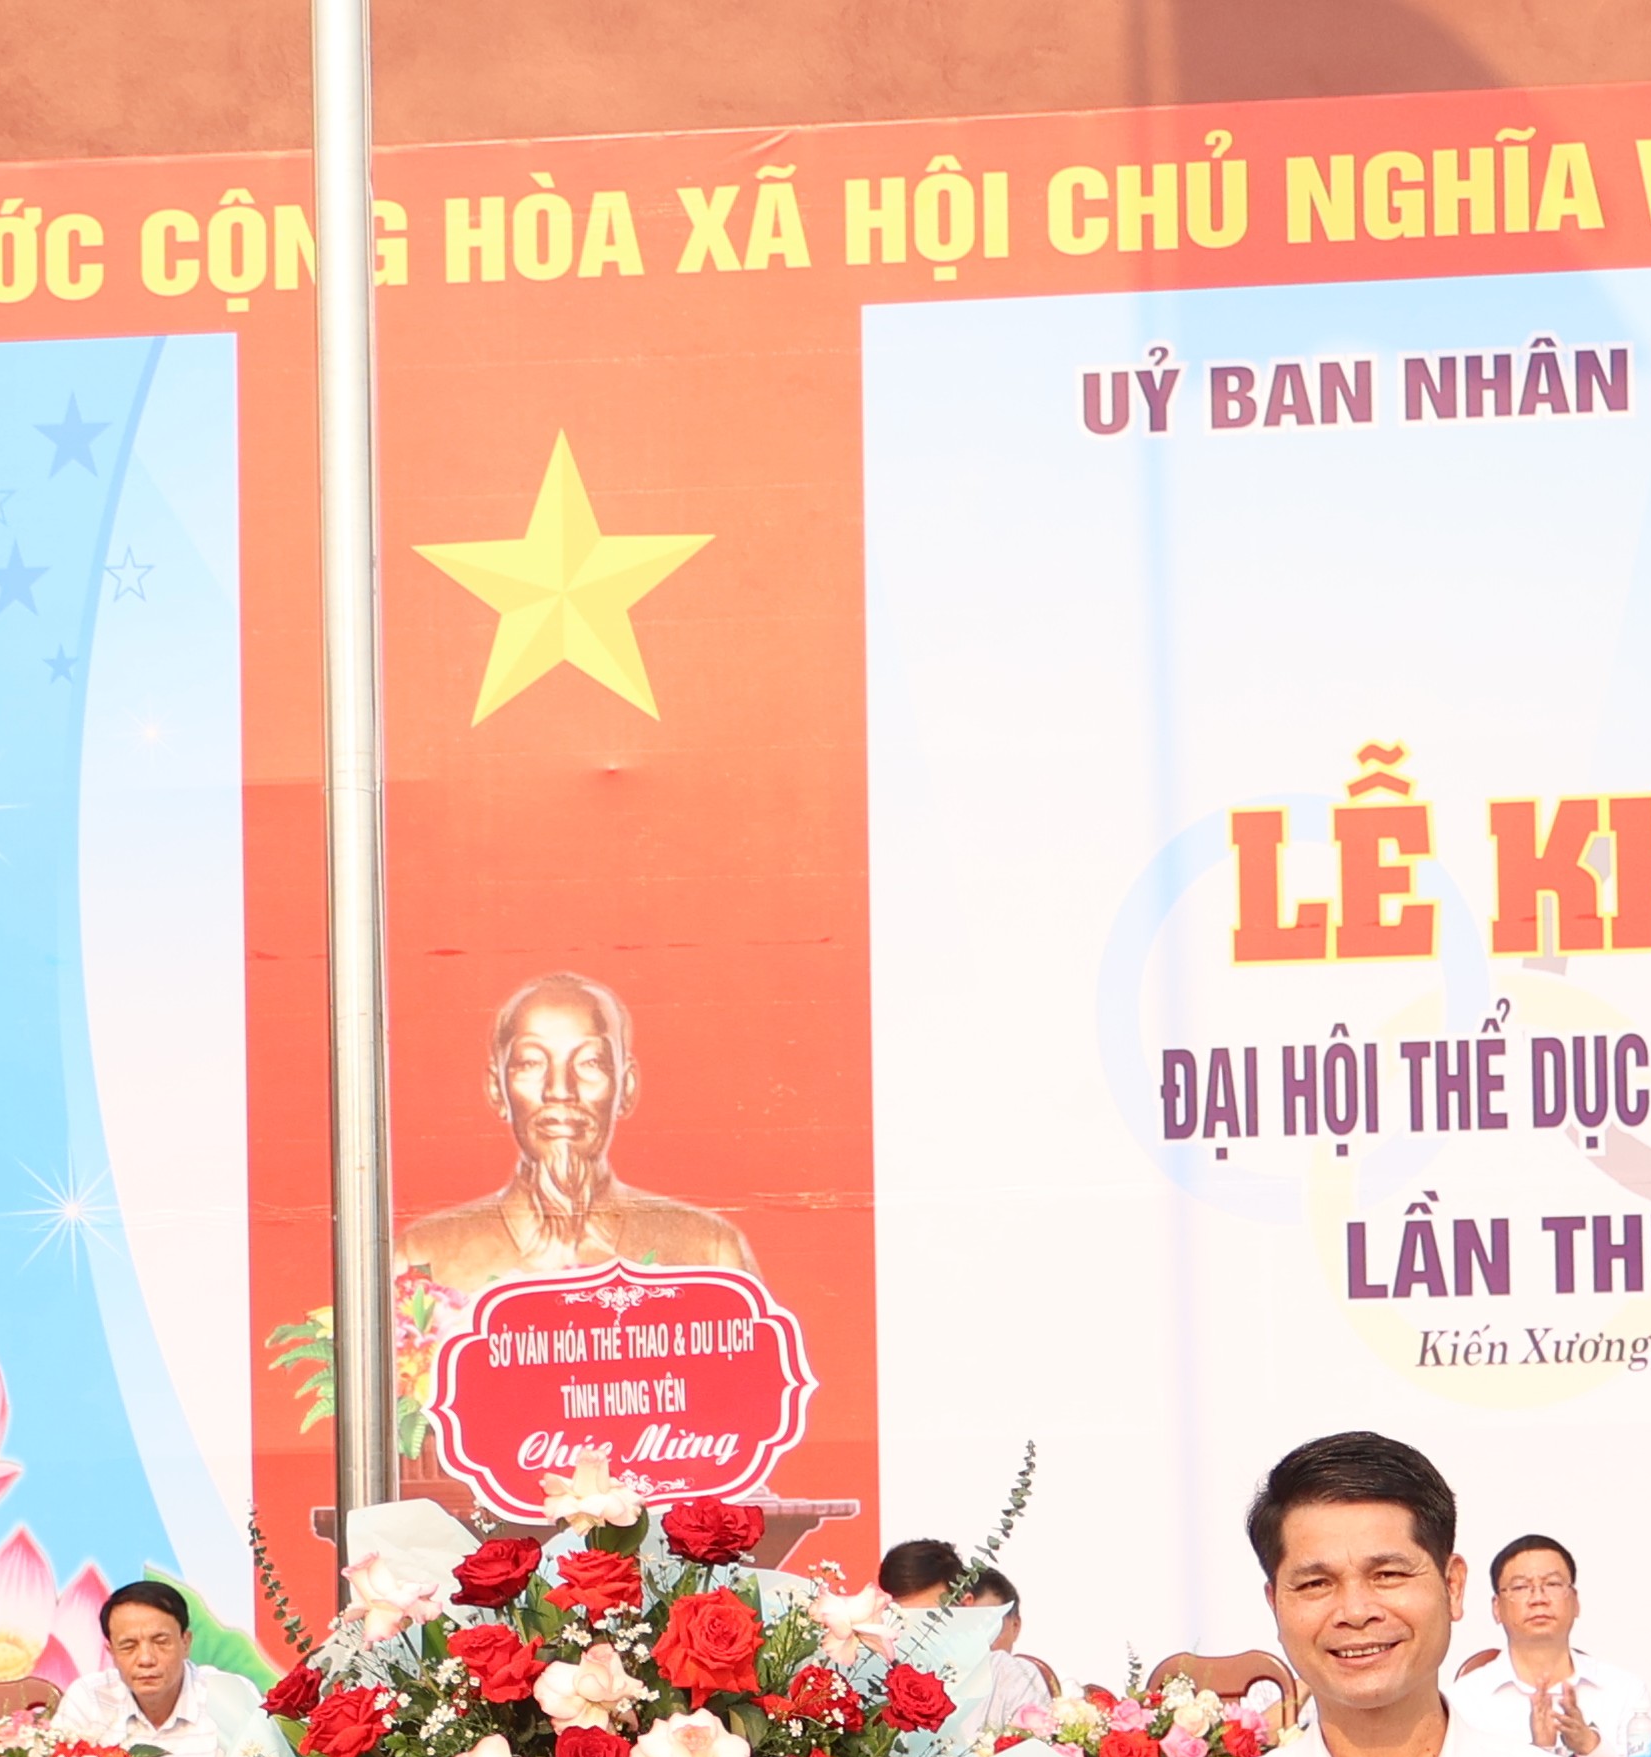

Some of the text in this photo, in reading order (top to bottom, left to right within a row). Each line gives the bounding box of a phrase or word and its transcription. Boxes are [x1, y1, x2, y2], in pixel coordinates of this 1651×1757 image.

[444, 172, 644, 284] HÒA
[676, 162, 811, 273] XÃ
[845, 154, 1009, 281] HỘI
[1047, 129, 1247, 257] CHỦ
[1285, 125, 1605, 244] NGHĨA
[1081, 345, 1180, 435] UỶ
[1209, 359, 1374, 430] BAN
[1403, 336, 1629, 421] NHÂN
[1230, 742, 1440, 965] LỄ
[1160, 1046, 1259, 1161] ĐẠI
[1281, 1022, 1379, 1157] HỘI
[1400, 997, 1509, 1133] THỂ
[1531, 1032, 1650, 1149] DỤC
[1347, 1190, 1511, 1301] LẦN
[488, 1311, 755, 1368] SỞ VĂN HÓA THỂ THAO & DU LỊCH
[1415, 1323, 1510, 1369] Kiến
[560, 1372, 686, 1419] TỈNH HƯNG YÊN
[620, 1423, 740, 1466] Mừng
